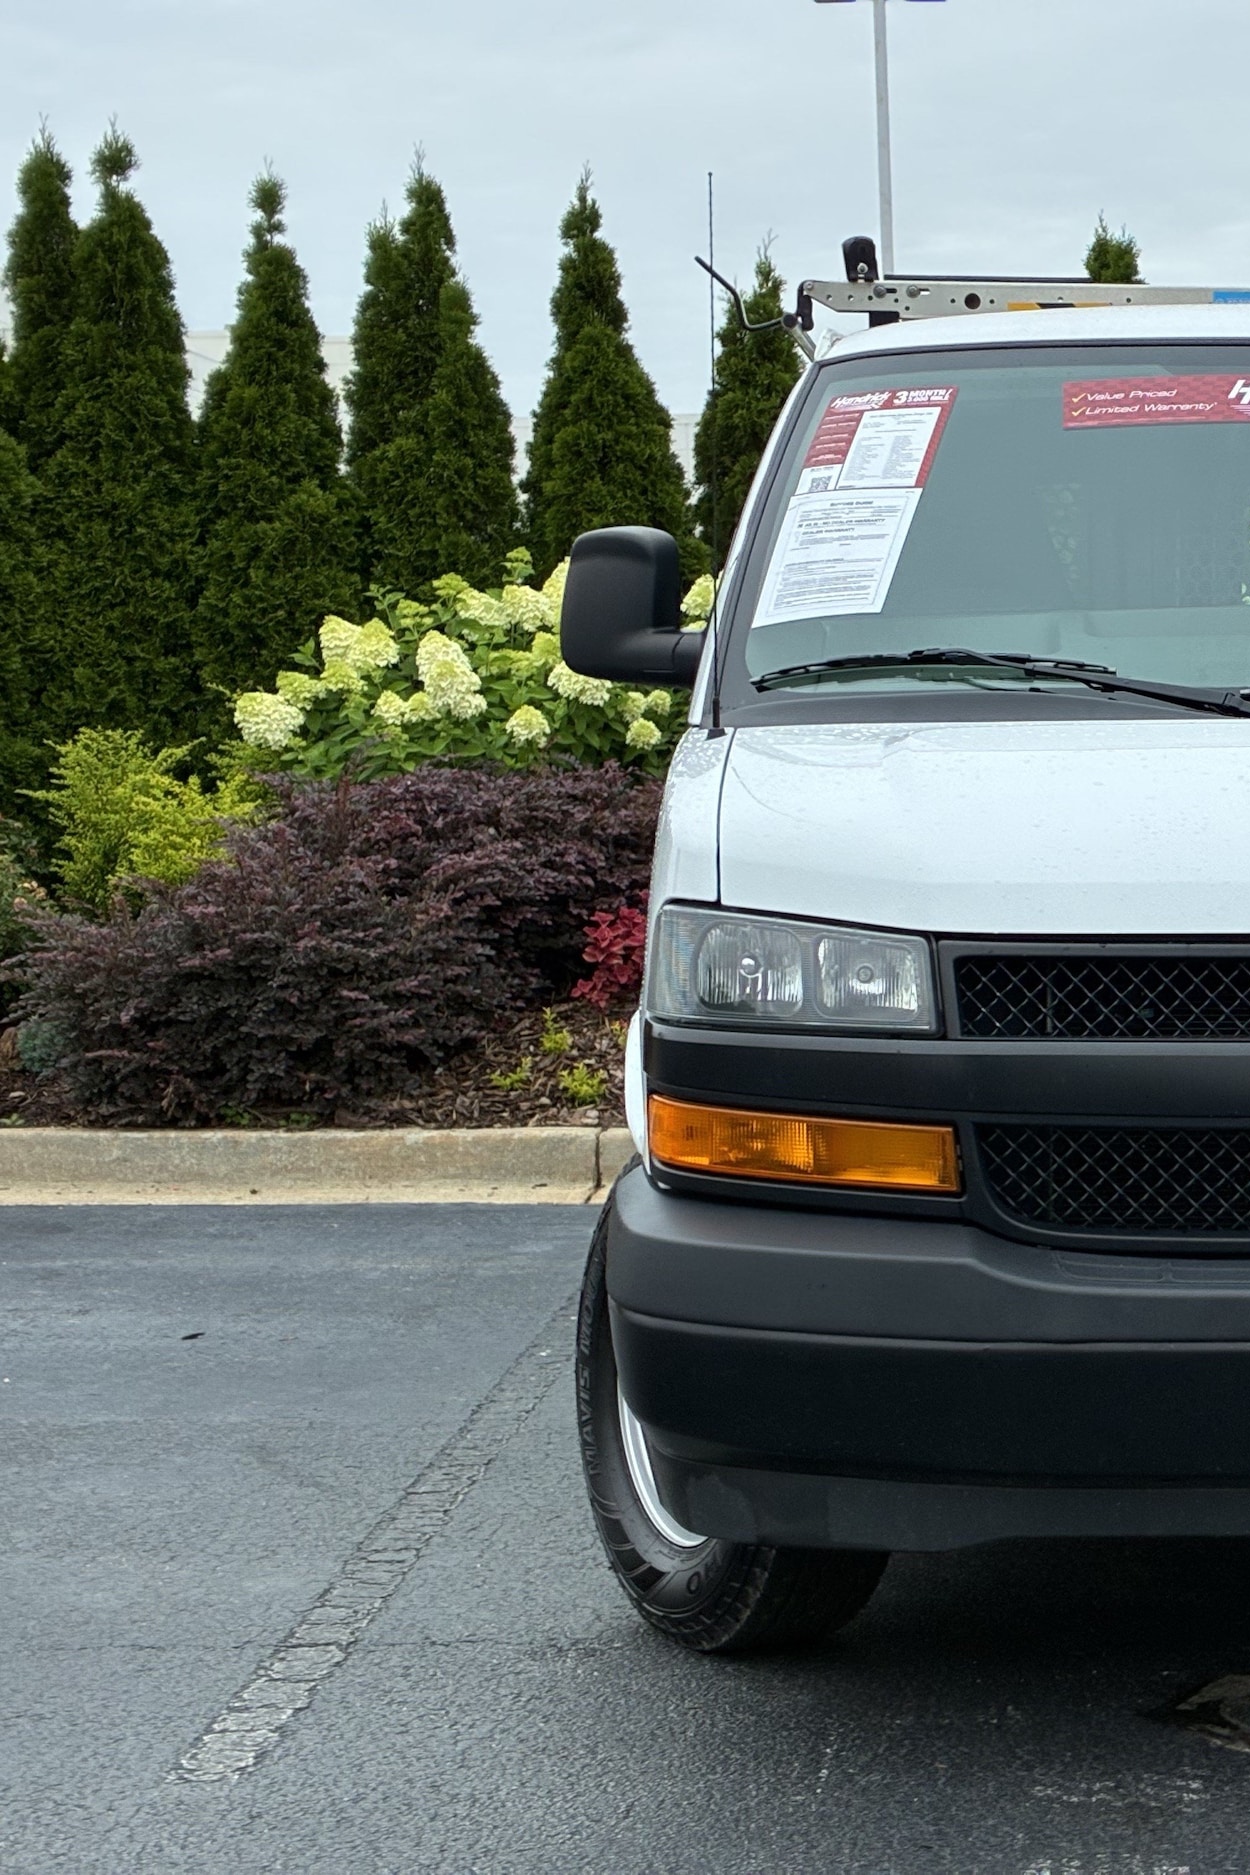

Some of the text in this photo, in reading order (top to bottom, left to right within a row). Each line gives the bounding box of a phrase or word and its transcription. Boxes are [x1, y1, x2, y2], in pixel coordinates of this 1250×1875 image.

[893, 390, 908, 404] 3
[1085, 388, 1177, 401] Value Priced
[1085, 404, 1140, 415] Limited
